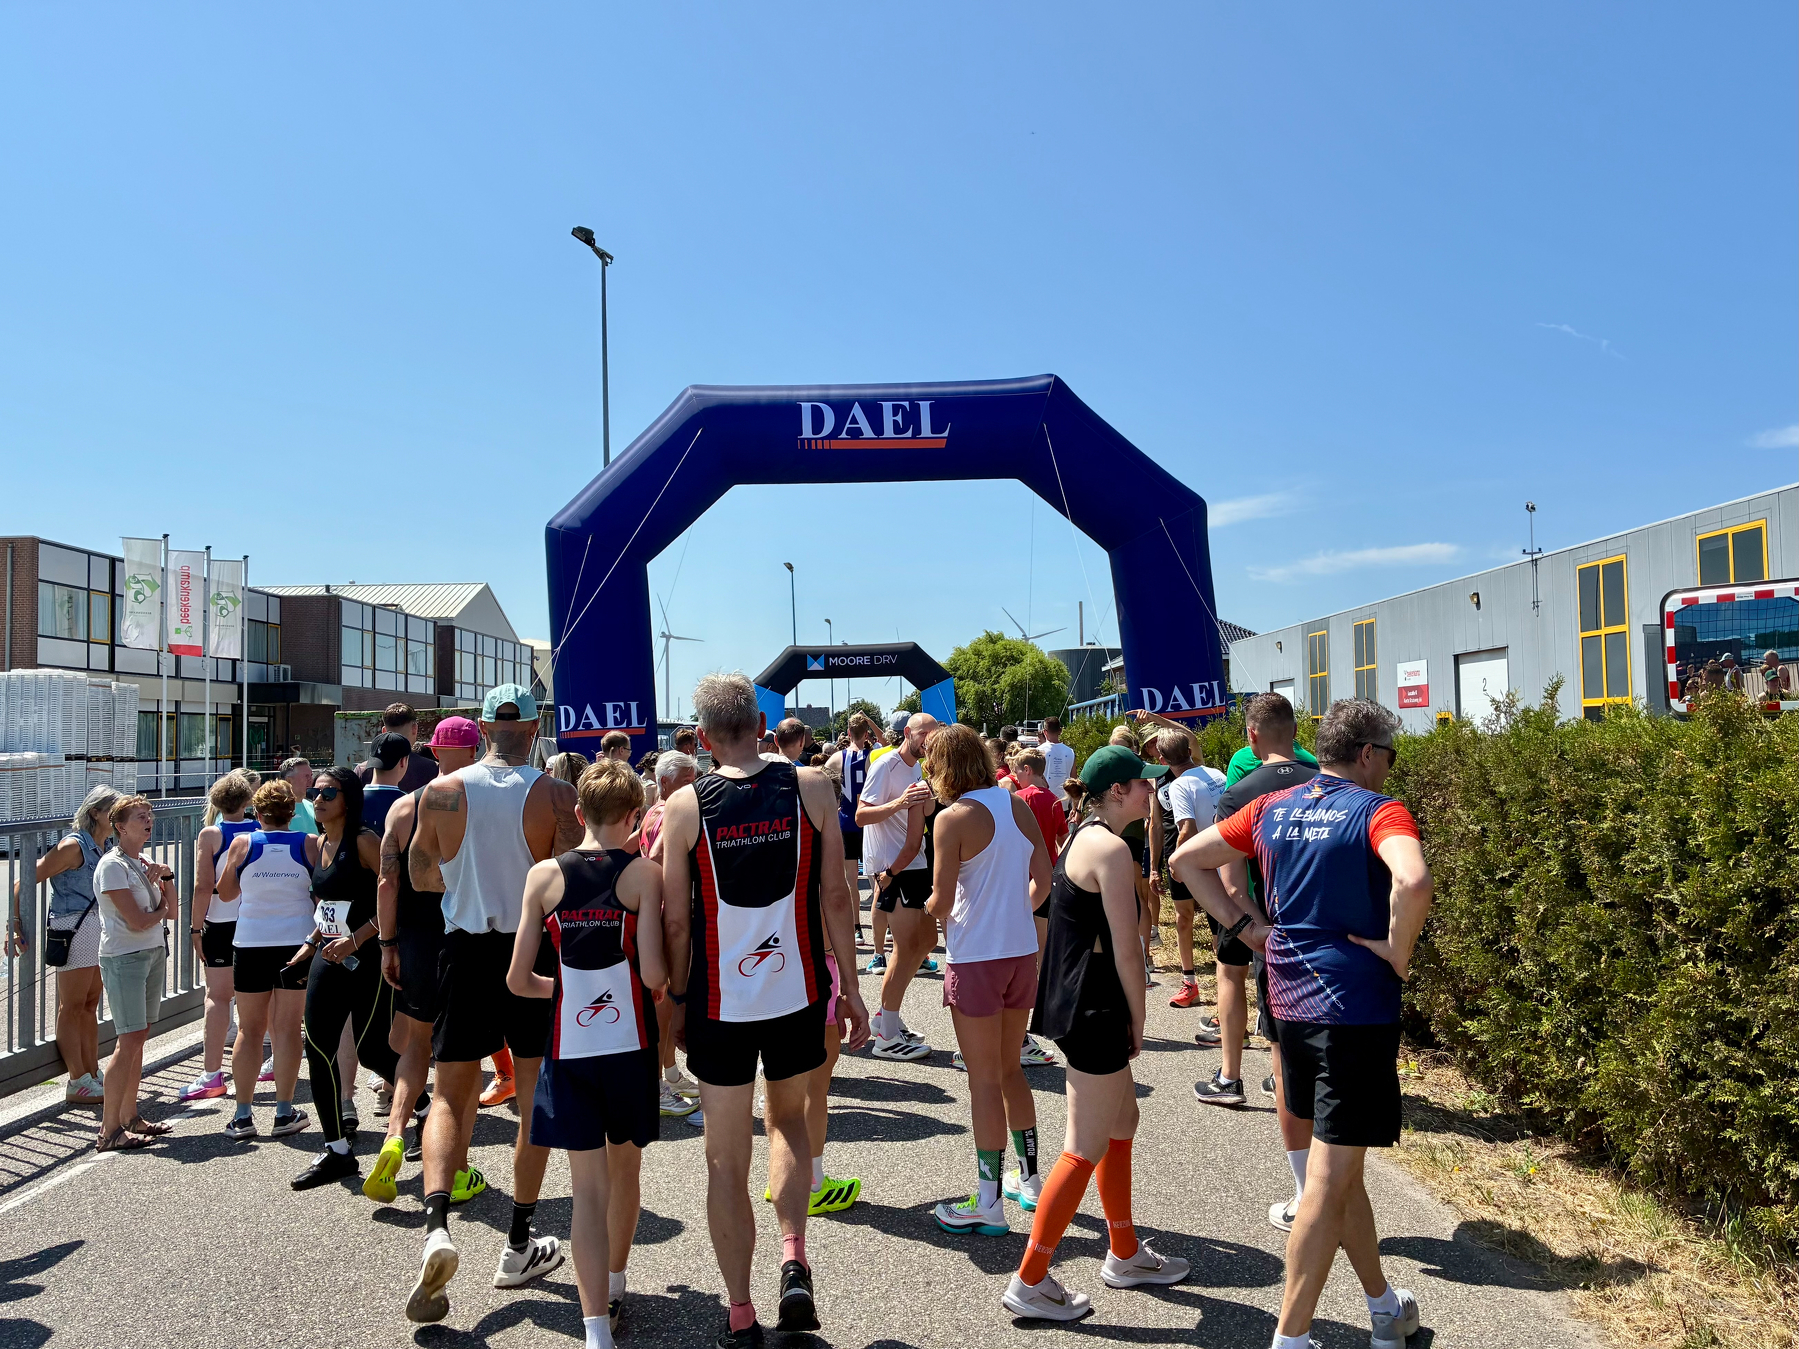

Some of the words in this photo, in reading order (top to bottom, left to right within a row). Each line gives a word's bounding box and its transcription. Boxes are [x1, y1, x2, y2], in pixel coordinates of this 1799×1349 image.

[796, 400, 951, 438] DAEL
[829, 656, 871, 666] MOORE
[874, 654, 897, 665] DRV
[1482, 677, 1487, 692] 2
[1140, 680, 1226, 713] DAEL
[558, 701, 647, 731] DAEL
[1273, 807, 1289, 822] TE
[716, 817, 792, 841] PACTRAC
[1272, 824, 1282, 840] A
[1303, 826, 1333, 842] META
[716, 835, 766, 849] TRIATHLON
[767, 831, 791, 841] CLUB
[561, 909, 623, 921] PACTRAC
[1026, 1138, 1036, 1156] RDAM
